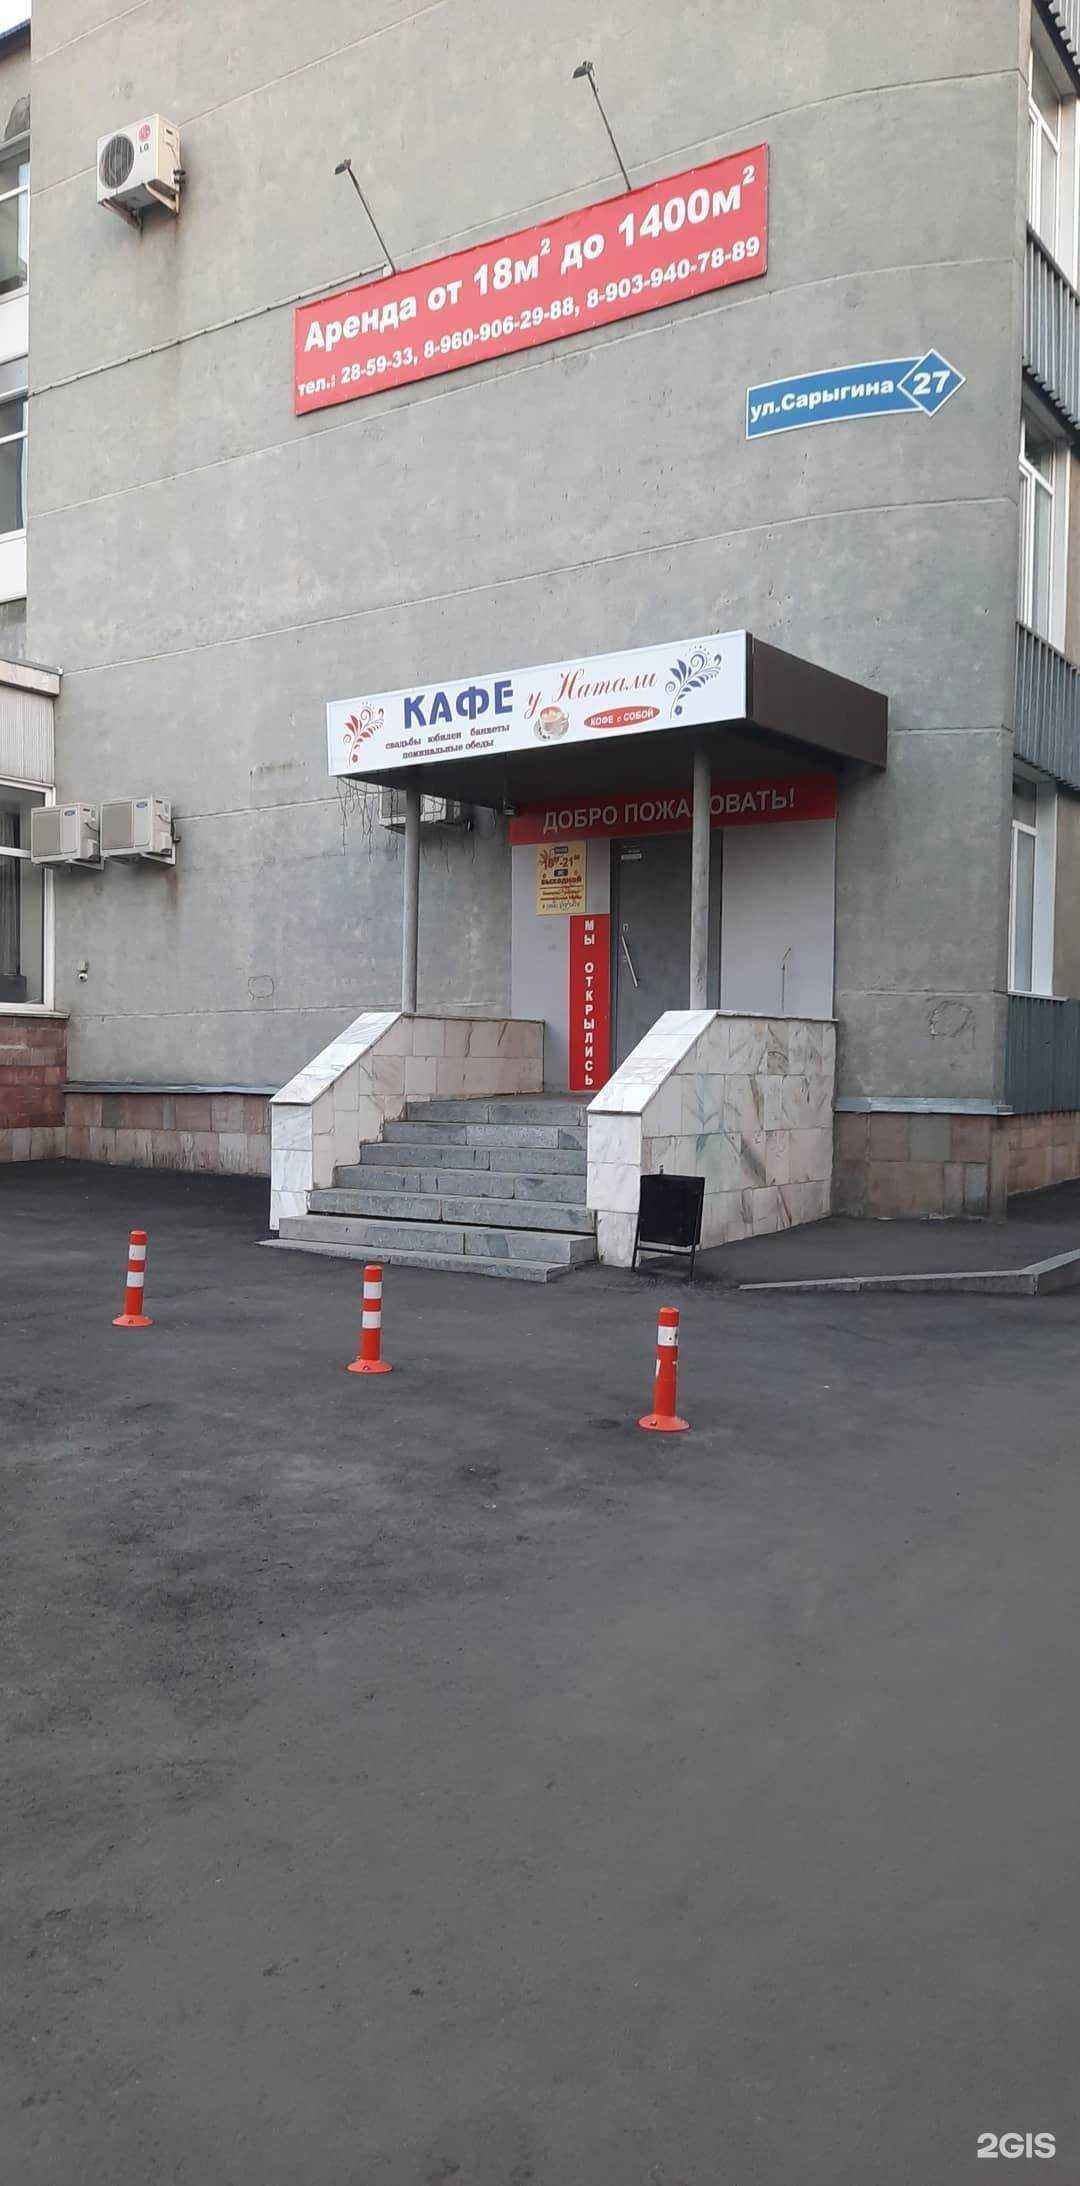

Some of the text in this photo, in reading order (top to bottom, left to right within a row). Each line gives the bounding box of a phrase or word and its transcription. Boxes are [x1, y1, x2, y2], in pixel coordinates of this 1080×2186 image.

[304, 301, 417, 352] Аренда
[428, 280, 463, 312] от
[561, 233, 605, 273] до
[341, 348, 418, 385] 28-59-33,
[423, 301, 580, 360] 8-960-906-29-88,
[586, 237, 760, 308] 8-903-940-78-89
[750, 379, 894, 423] ул.Сарыгина
[912, 370, 951, 395] 27
[403, 667, 657, 730] КАФЕ у Натали
[590, 716, 613, 726] КОФЕ
[623, 708, 654, 722] СОБОЙ
[385, 737, 422, 750] свадьбы
[470, 724, 510, 736] банкеты
[402, 739, 494, 759] поминальные обеды
[542, 787, 796, 834] ДОБРО ПОЖАОВАТЬ!
[583, 919, 595, 1086] МЫ ОТКРЫЛИСЬ
